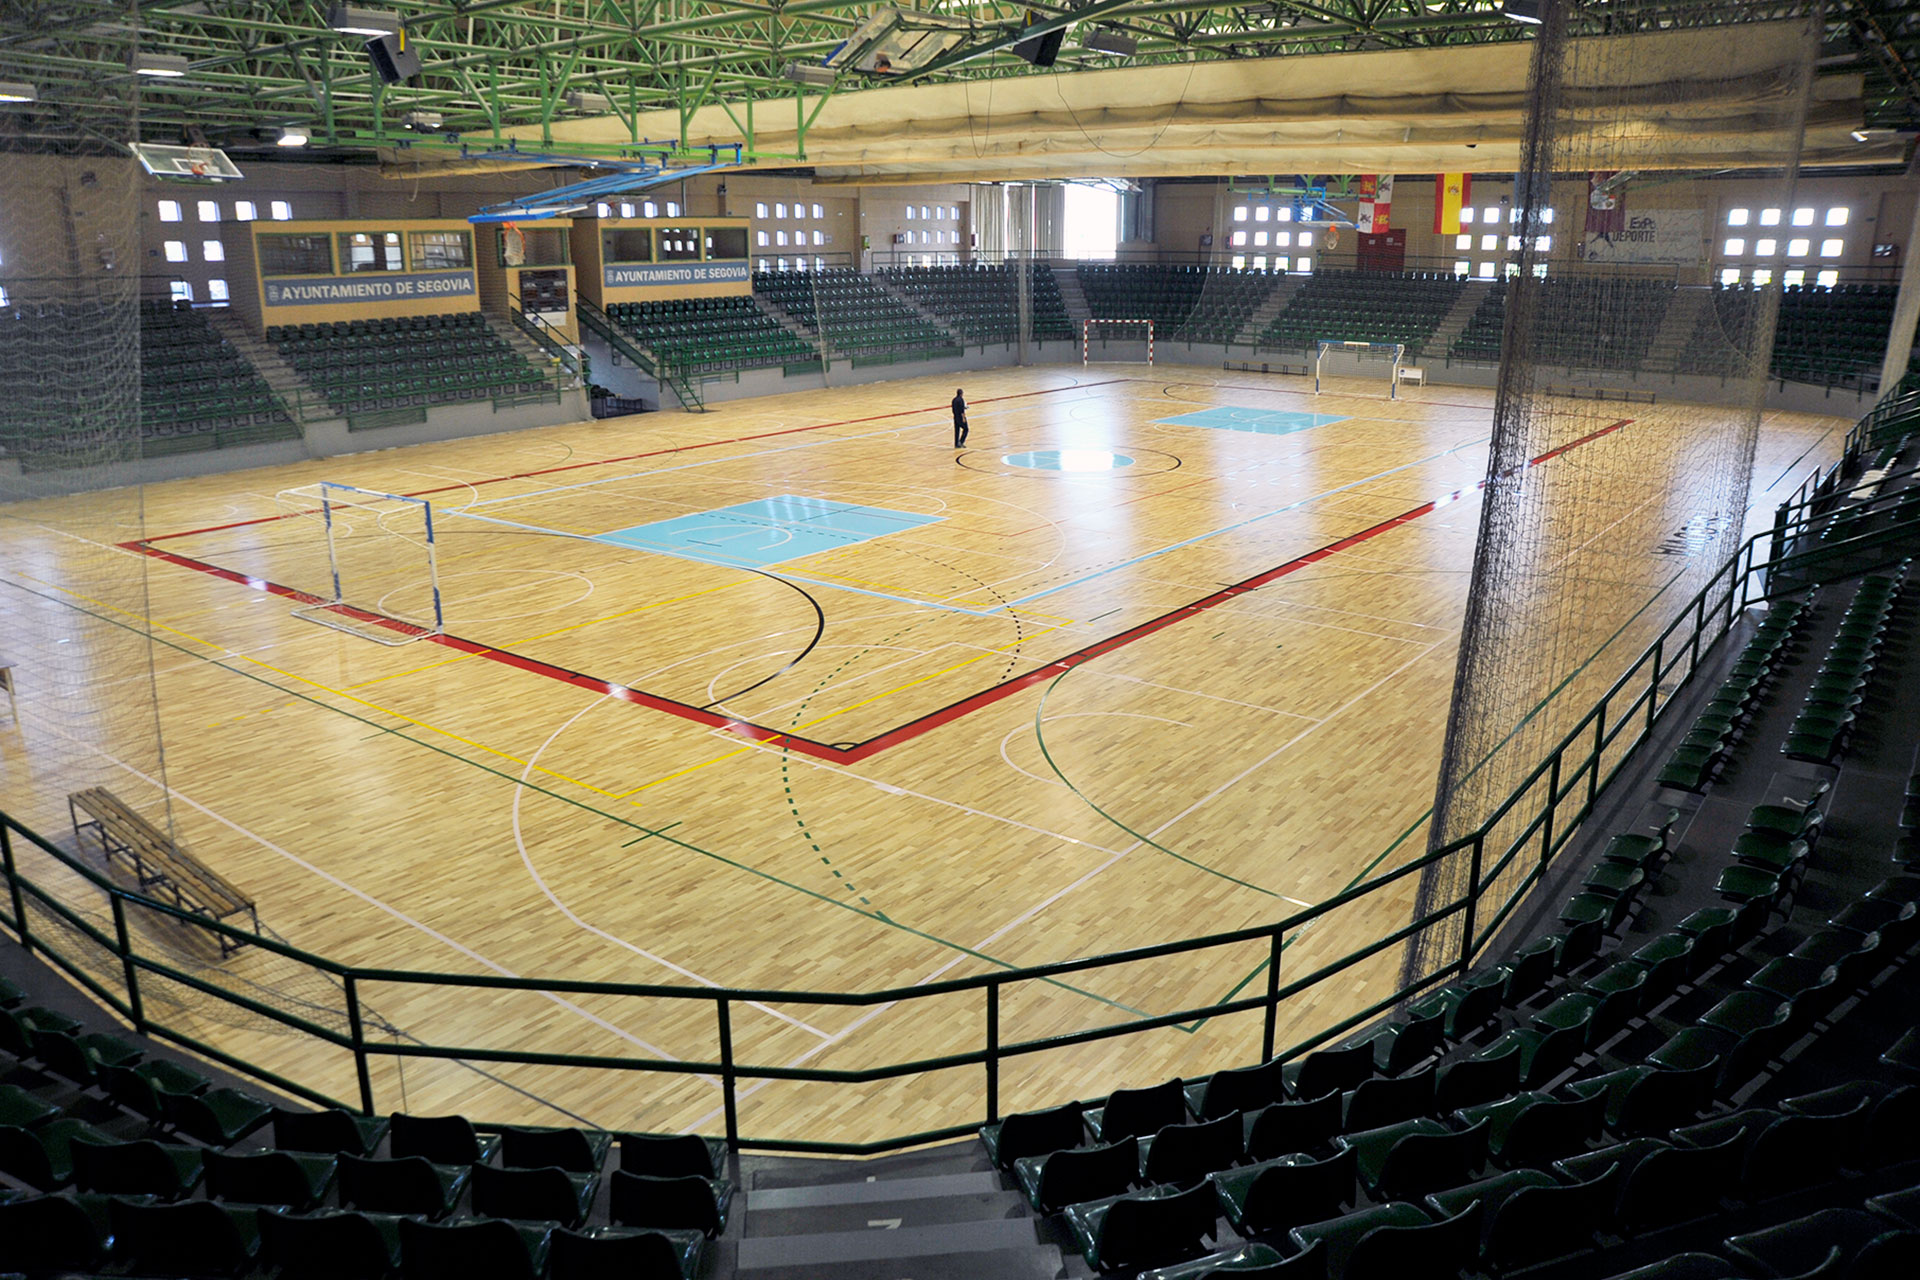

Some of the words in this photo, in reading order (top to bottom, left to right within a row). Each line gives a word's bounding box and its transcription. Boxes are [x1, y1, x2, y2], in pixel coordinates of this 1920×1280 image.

[1613, 230, 1655, 242] DEPORTE
[615, 268, 692, 282] AYUNTAMIENTO
[694, 268, 707, 279] DE
[708, 267, 747, 279] SEGOVIA
[281, 282, 393, 300] AYUNTAMIENTO
[396, 281, 414, 294] DE
[417, 278, 472, 293] SEGOVIA
